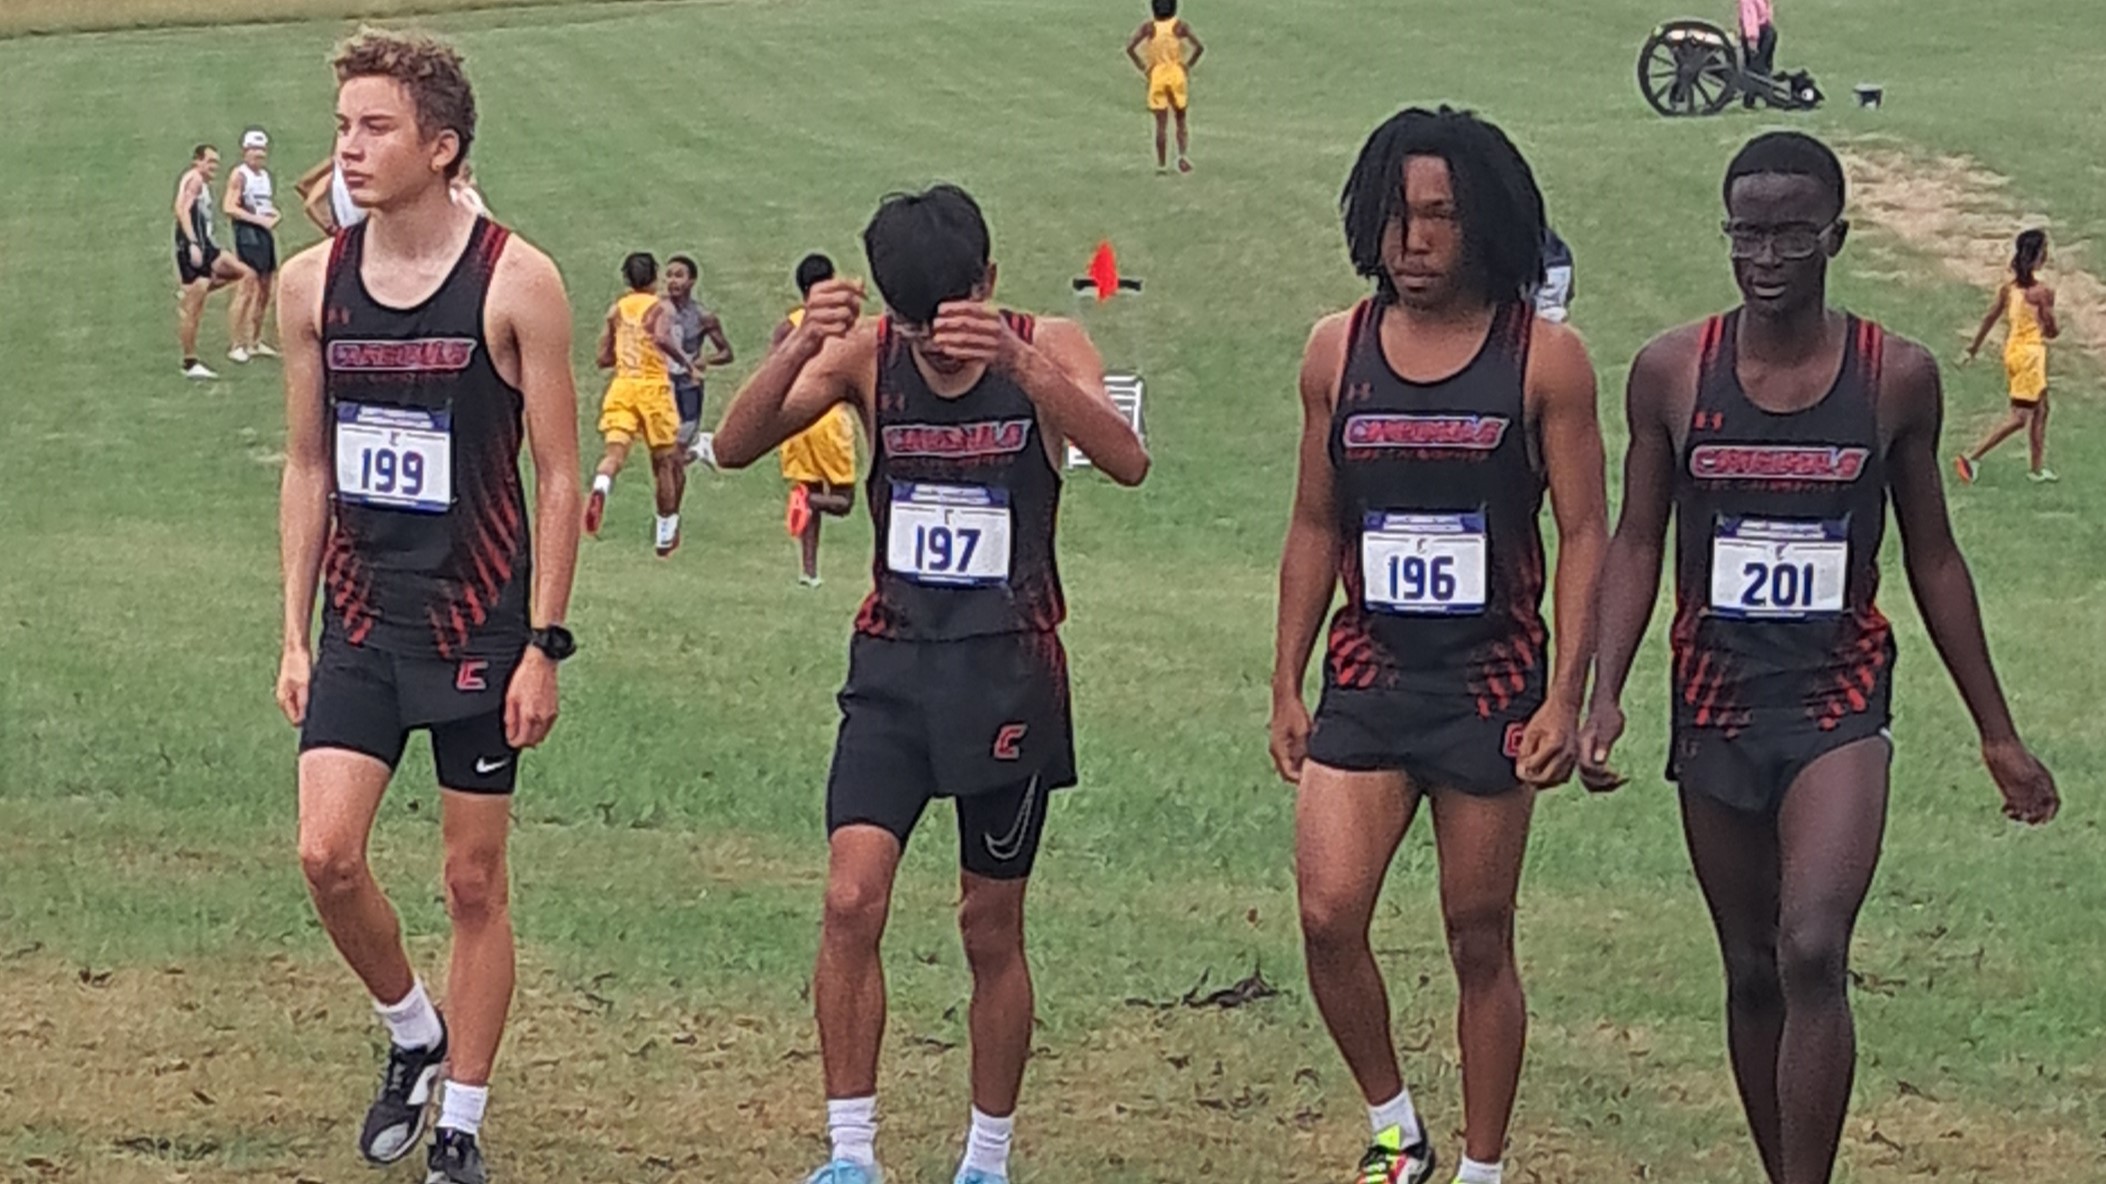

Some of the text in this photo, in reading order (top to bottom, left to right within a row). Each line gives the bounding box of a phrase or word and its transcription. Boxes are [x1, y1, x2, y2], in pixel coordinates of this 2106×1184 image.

[361, 448, 424, 496] 199
[915, 525, 981, 573] 197
[1388, 555, 1457, 601] 196
[1740, 562, 1814, 607] 201
[993, 723, 1028, 760] C
